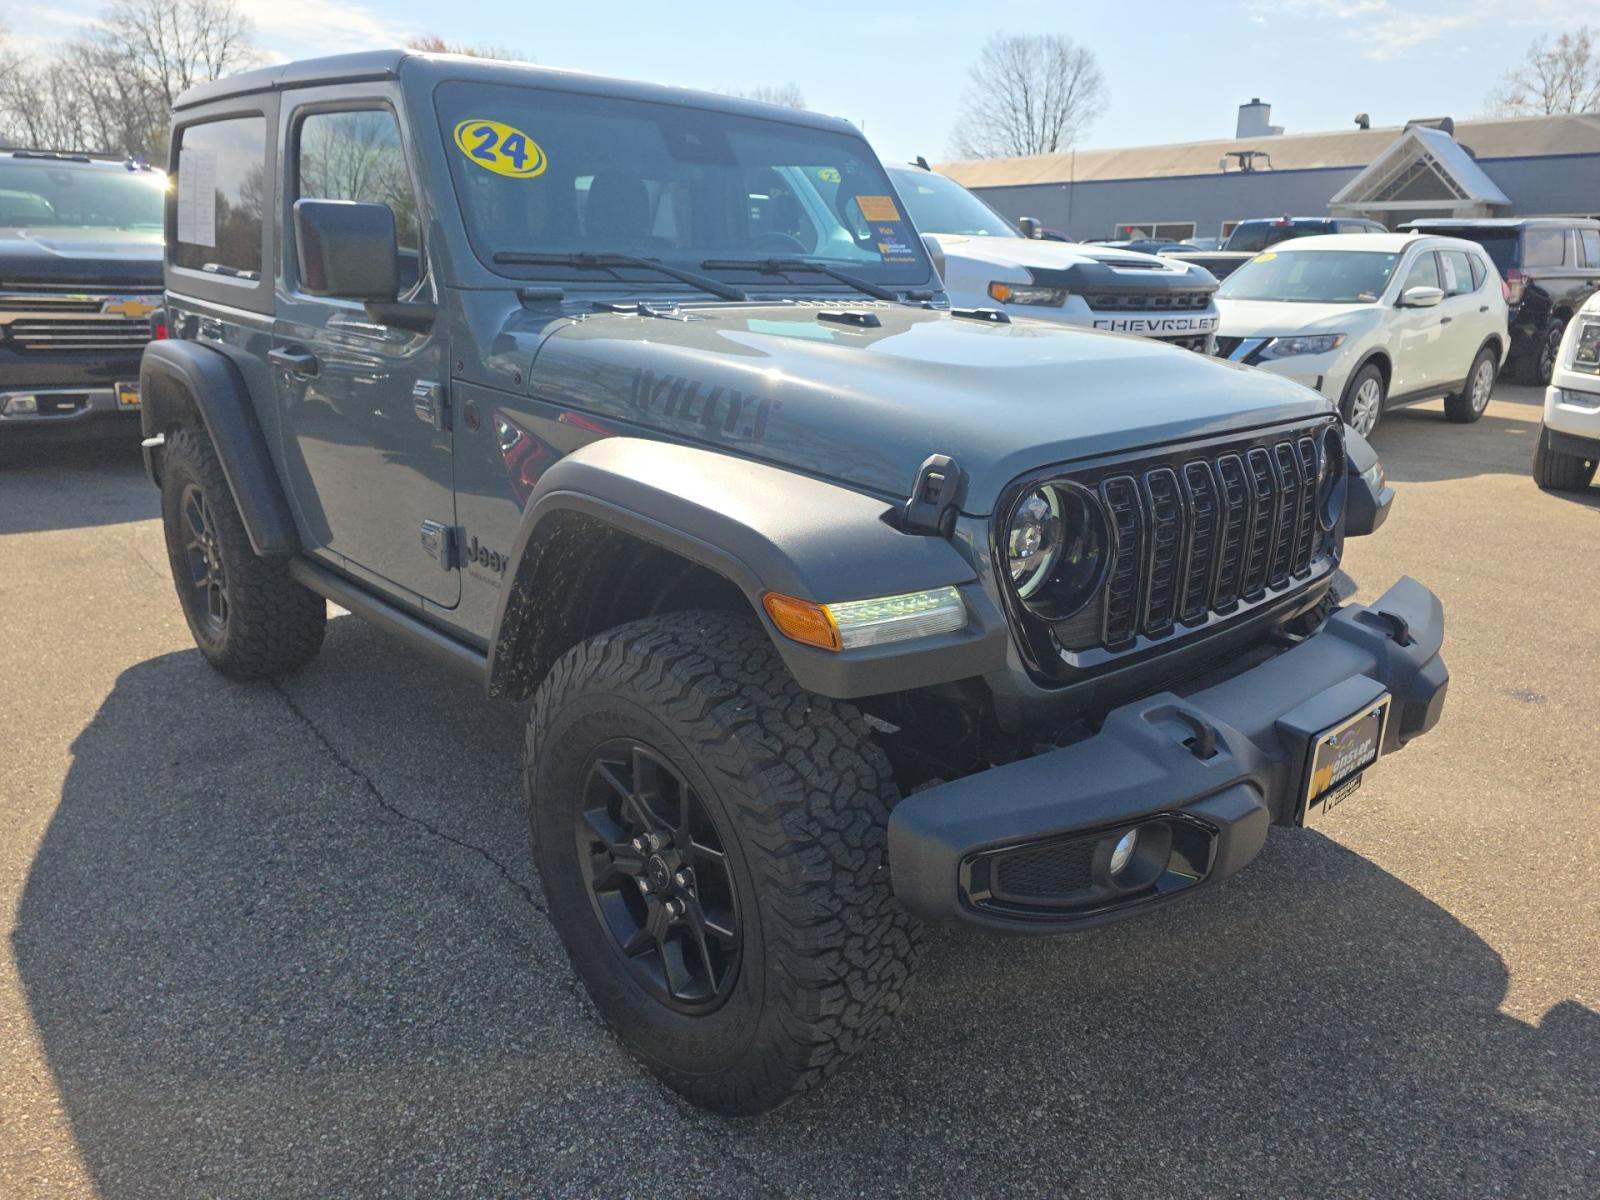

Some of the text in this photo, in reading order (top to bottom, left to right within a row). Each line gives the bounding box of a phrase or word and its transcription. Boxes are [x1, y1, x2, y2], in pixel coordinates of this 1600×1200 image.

[471, 126, 528, 169] 24
[1092, 318, 1218, 332] CHEVROLET
[467, 536, 510, 579] Jeep
